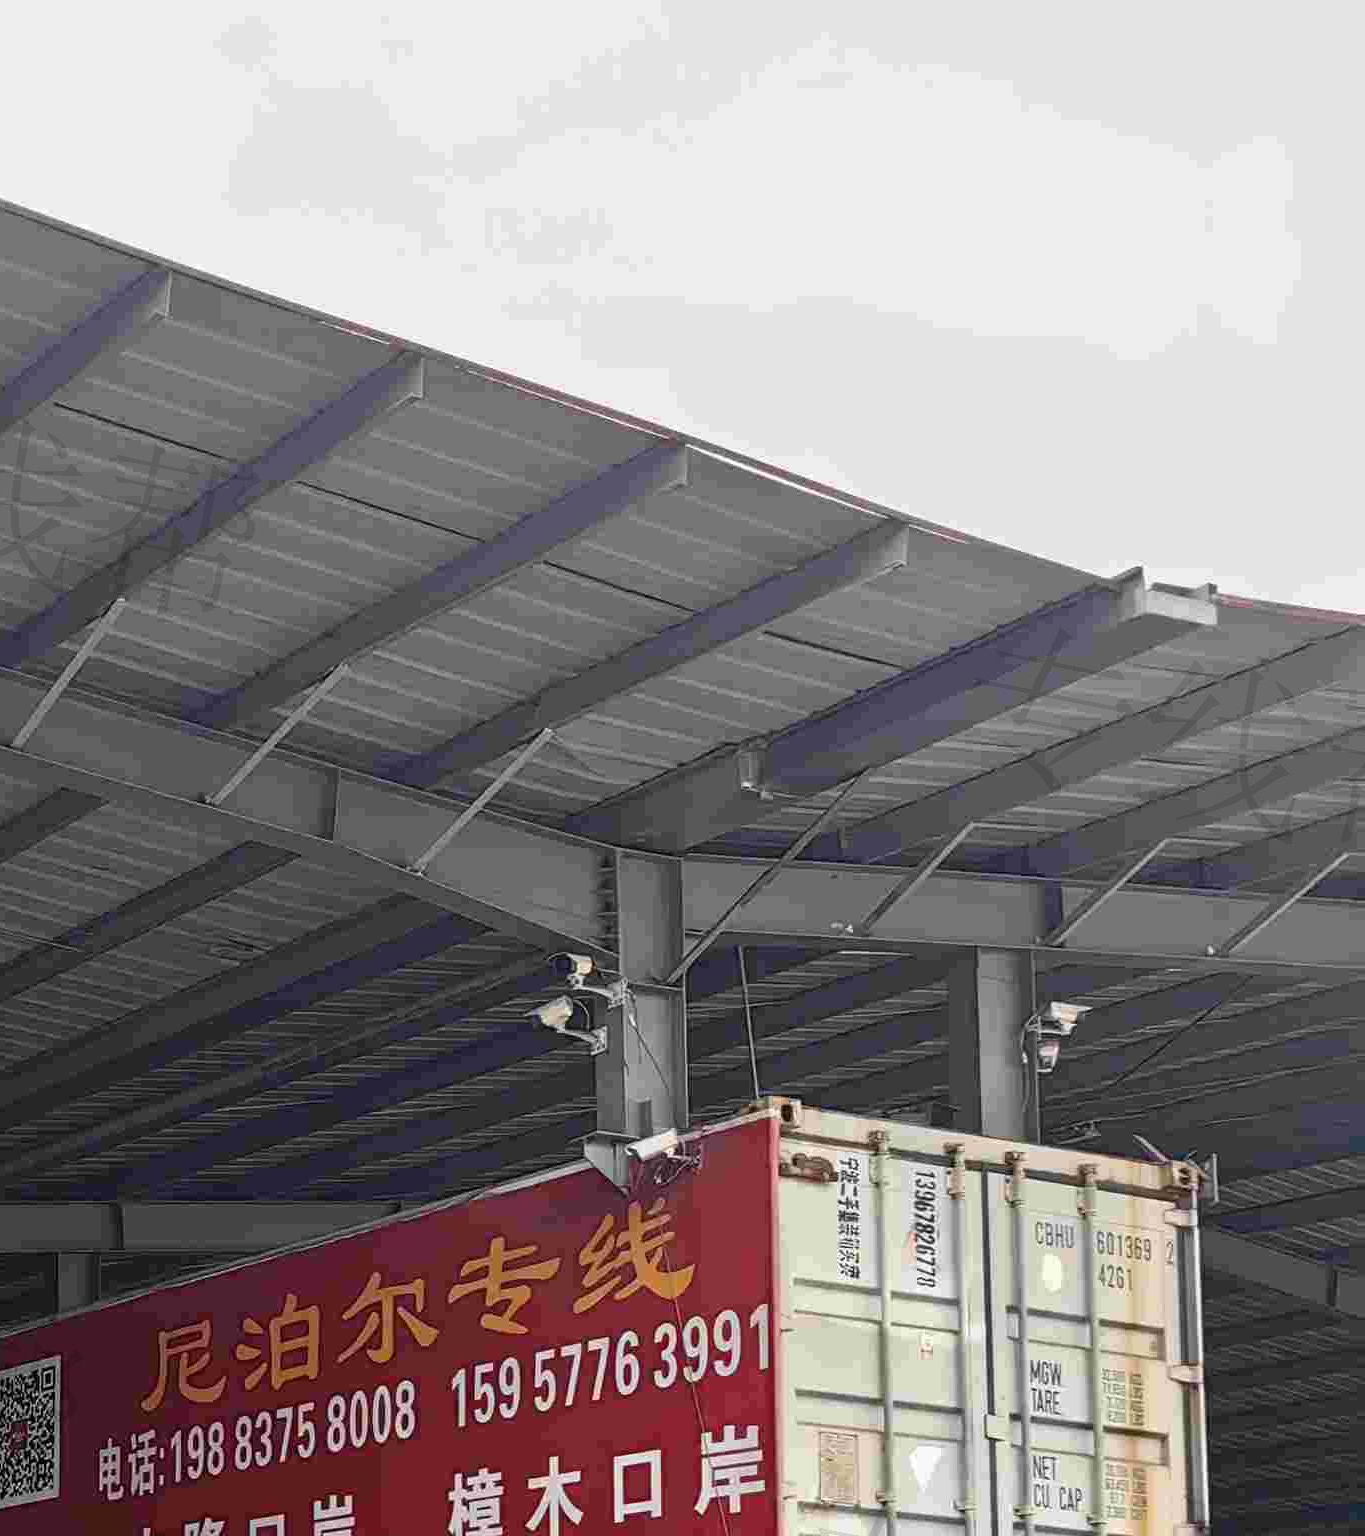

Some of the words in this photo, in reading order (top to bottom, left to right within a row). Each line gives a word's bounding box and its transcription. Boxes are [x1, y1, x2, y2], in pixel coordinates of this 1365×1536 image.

[914, 1171, 936, 1288] 13967826778
[1035, 1221, 1075, 1248] CBHU
[1096, 1230, 1152, 1261] 601369
[141, 1198, 694, 1411] 尼泊尔专线
[234, 1402, 315, 1471] 8375
[325, 1380, 417, 1454] 8008
[450, 1357, 522, 1428] 159
[532, 1330, 640, 1411] 5776
[652, 1302, 770, 1390] 3991
[1030, 1360, 1062, 1386] MGW
[1031, 1388, 1061, 1415] TARE
[1032, 1455, 1057, 1481] NET
